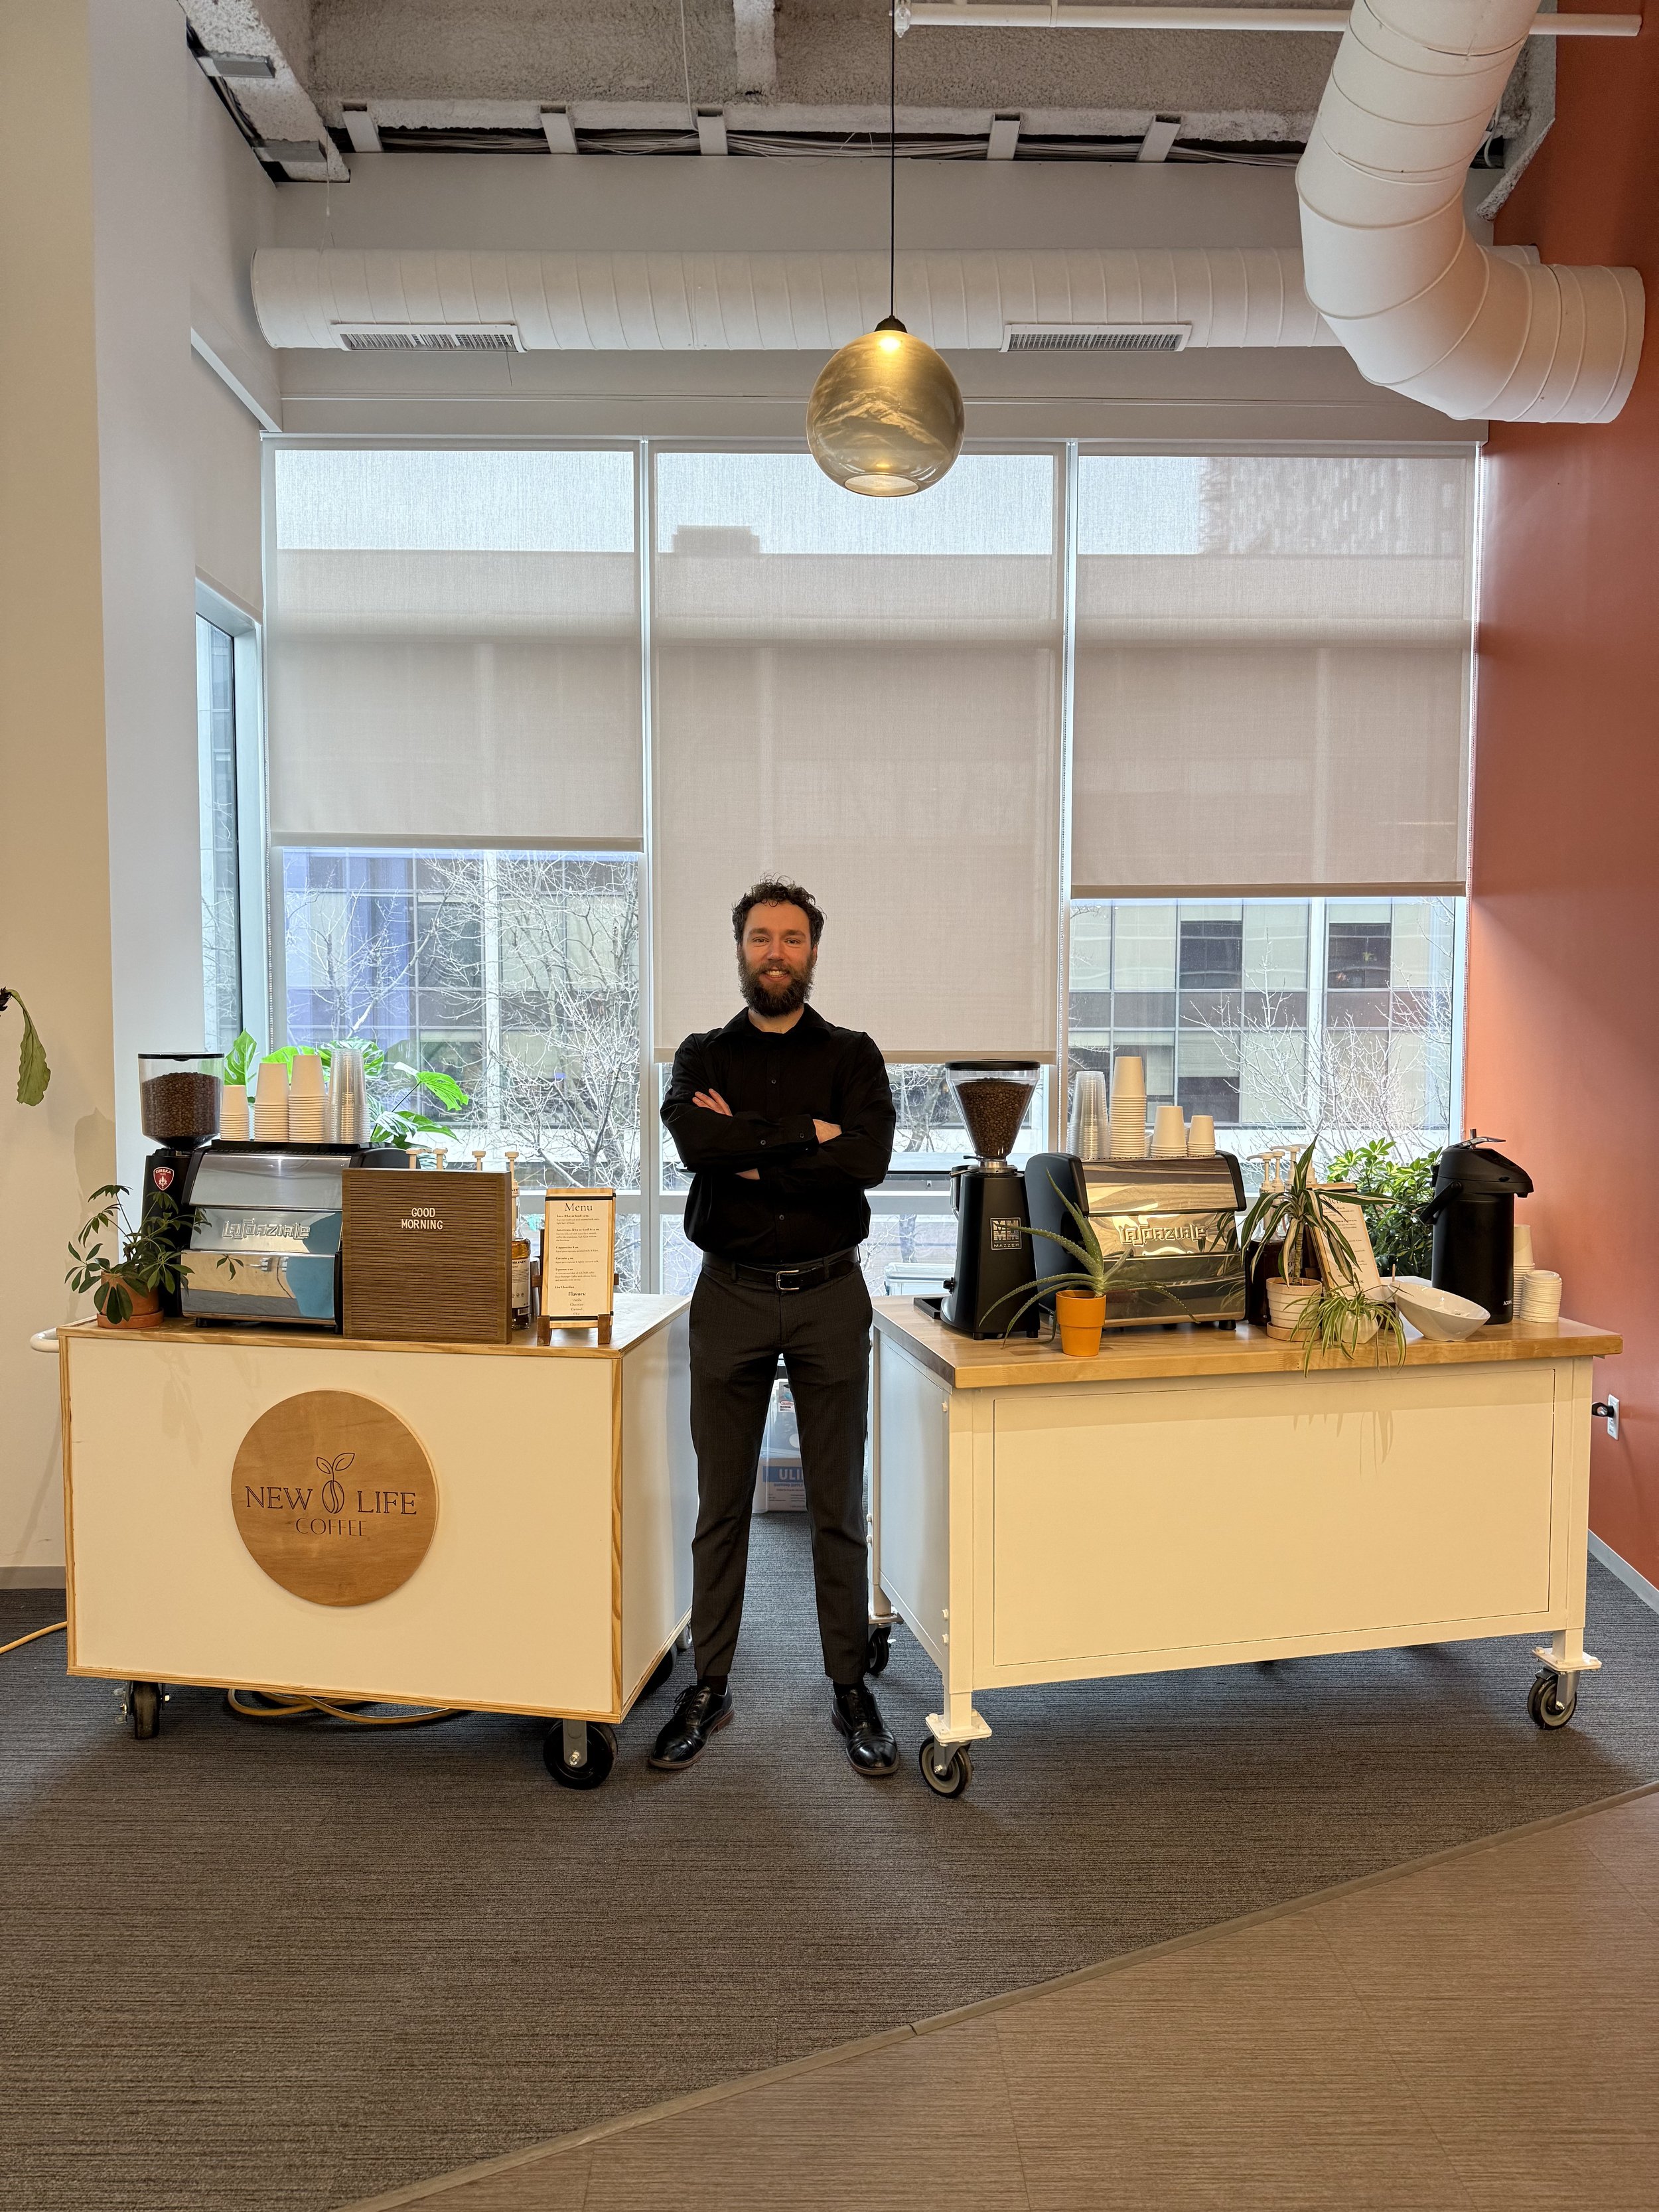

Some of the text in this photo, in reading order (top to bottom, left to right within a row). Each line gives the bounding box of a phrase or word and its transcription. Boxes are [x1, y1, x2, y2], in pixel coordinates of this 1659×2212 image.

[411, 1207, 436, 1218] GOOD
[565, 1203, 593, 1212] Menu
[401, 1218, 443, 1230] MORNING
[245, 1486, 417, 1514] NEW LIFE
[296, 1517, 367, 1536] COFFEE
